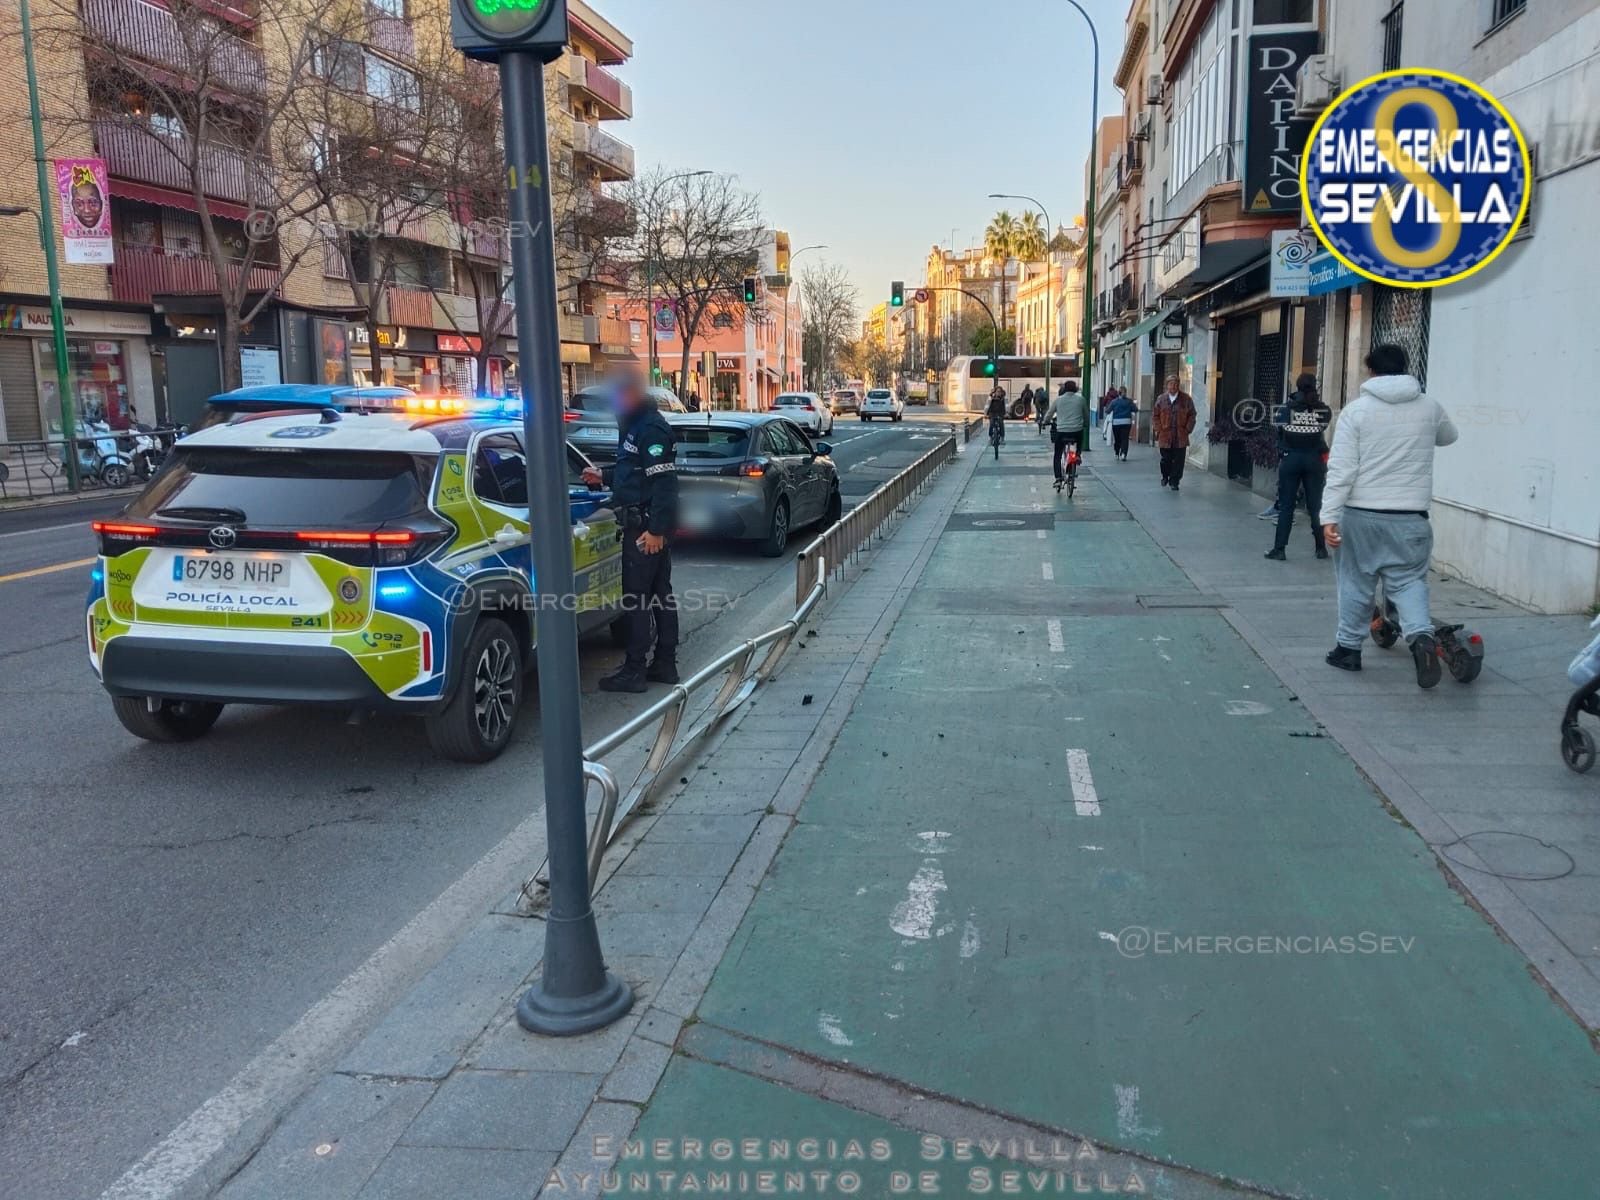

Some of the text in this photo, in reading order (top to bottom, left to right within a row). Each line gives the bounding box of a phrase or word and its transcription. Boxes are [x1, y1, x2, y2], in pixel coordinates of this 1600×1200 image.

[1259, 47, 1302, 198] DAPINO
[186, 559, 283, 583] 6798 NHP
[166, 591, 298, 606] POLICÍA LOCAL
[204, 605, 252, 613] SEVILLA
[291, 616, 322, 628] 241
[372, 632, 403, 642] 092
